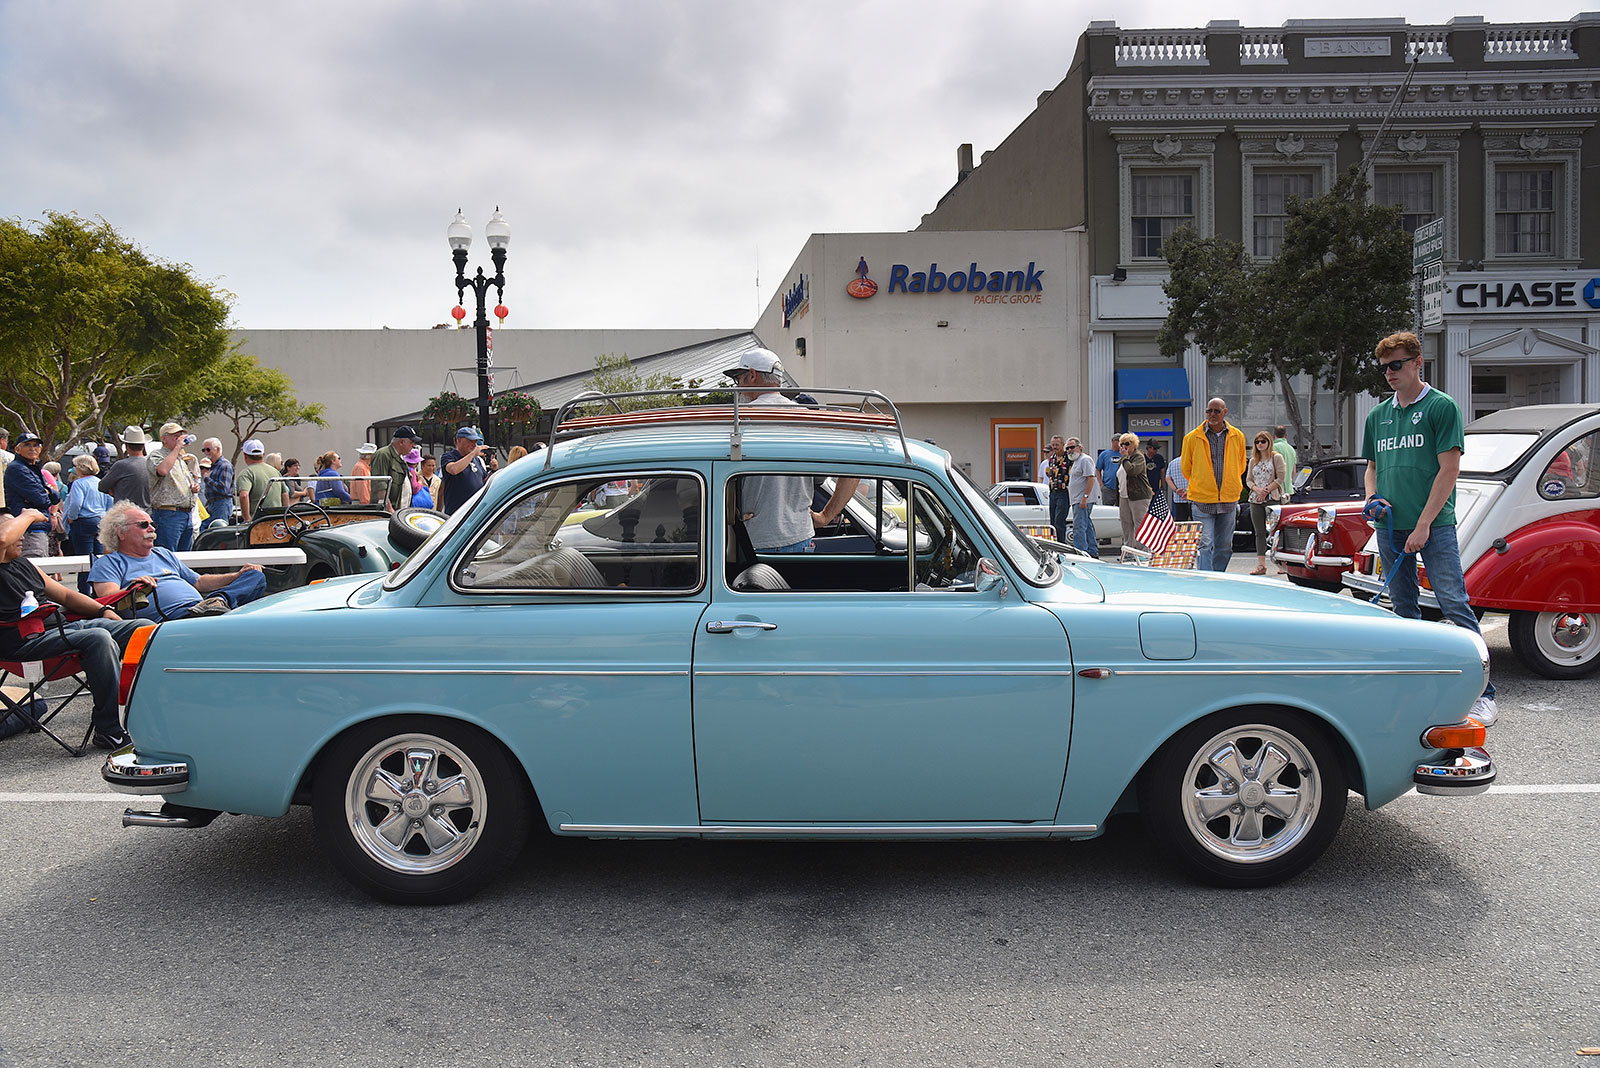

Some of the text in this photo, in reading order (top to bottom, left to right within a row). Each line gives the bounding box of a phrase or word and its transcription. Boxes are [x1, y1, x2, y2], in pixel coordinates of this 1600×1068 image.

[1318, 41, 1376, 54] BANK
[888, 261, 1045, 293] Rabobank
[973, 294, 1042, 305] PACIFIC GROVE
[1456, 281, 1577, 308] CHASE
[1145, 388, 1172, 401] ATM
[1130, 418, 1161, 427] CHASE
[1377, 433, 1425, 453] IRELAND
